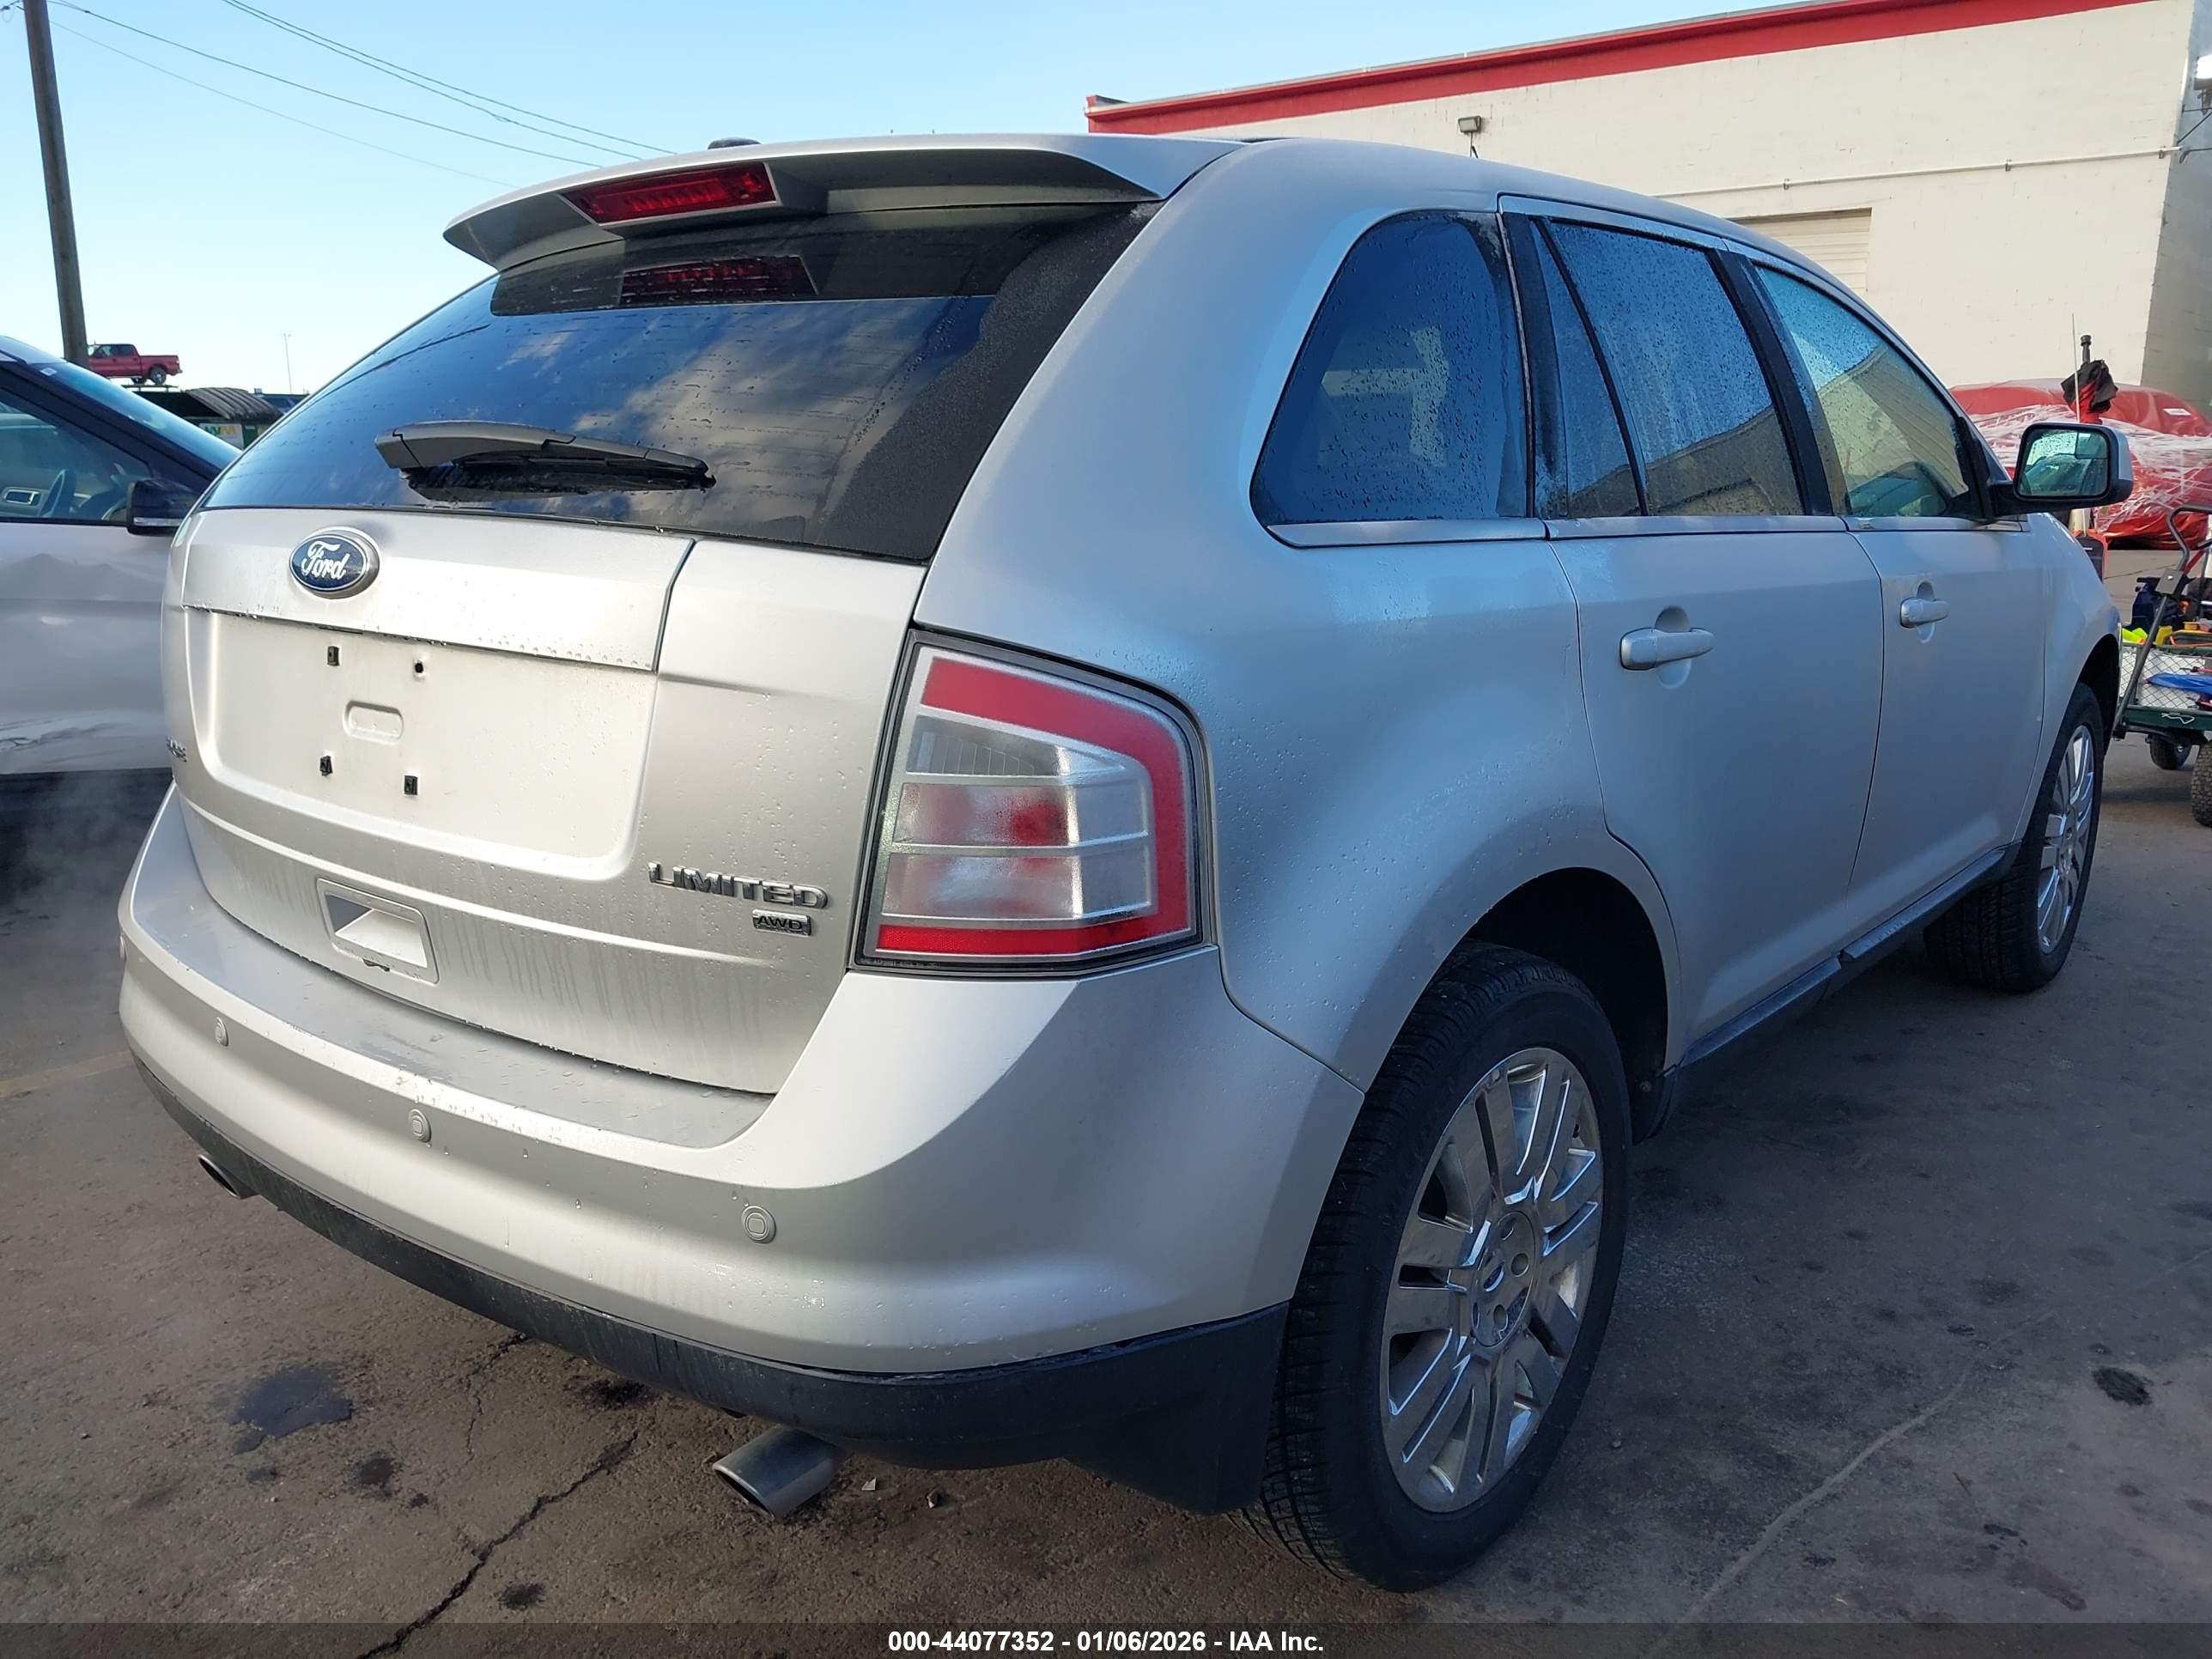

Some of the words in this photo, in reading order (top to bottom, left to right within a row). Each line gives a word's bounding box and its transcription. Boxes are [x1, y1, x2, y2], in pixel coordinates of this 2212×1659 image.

[301, 541, 350, 580] Ford
[648, 861, 828, 908] LIMITED
[757, 915, 804, 931] AWD
